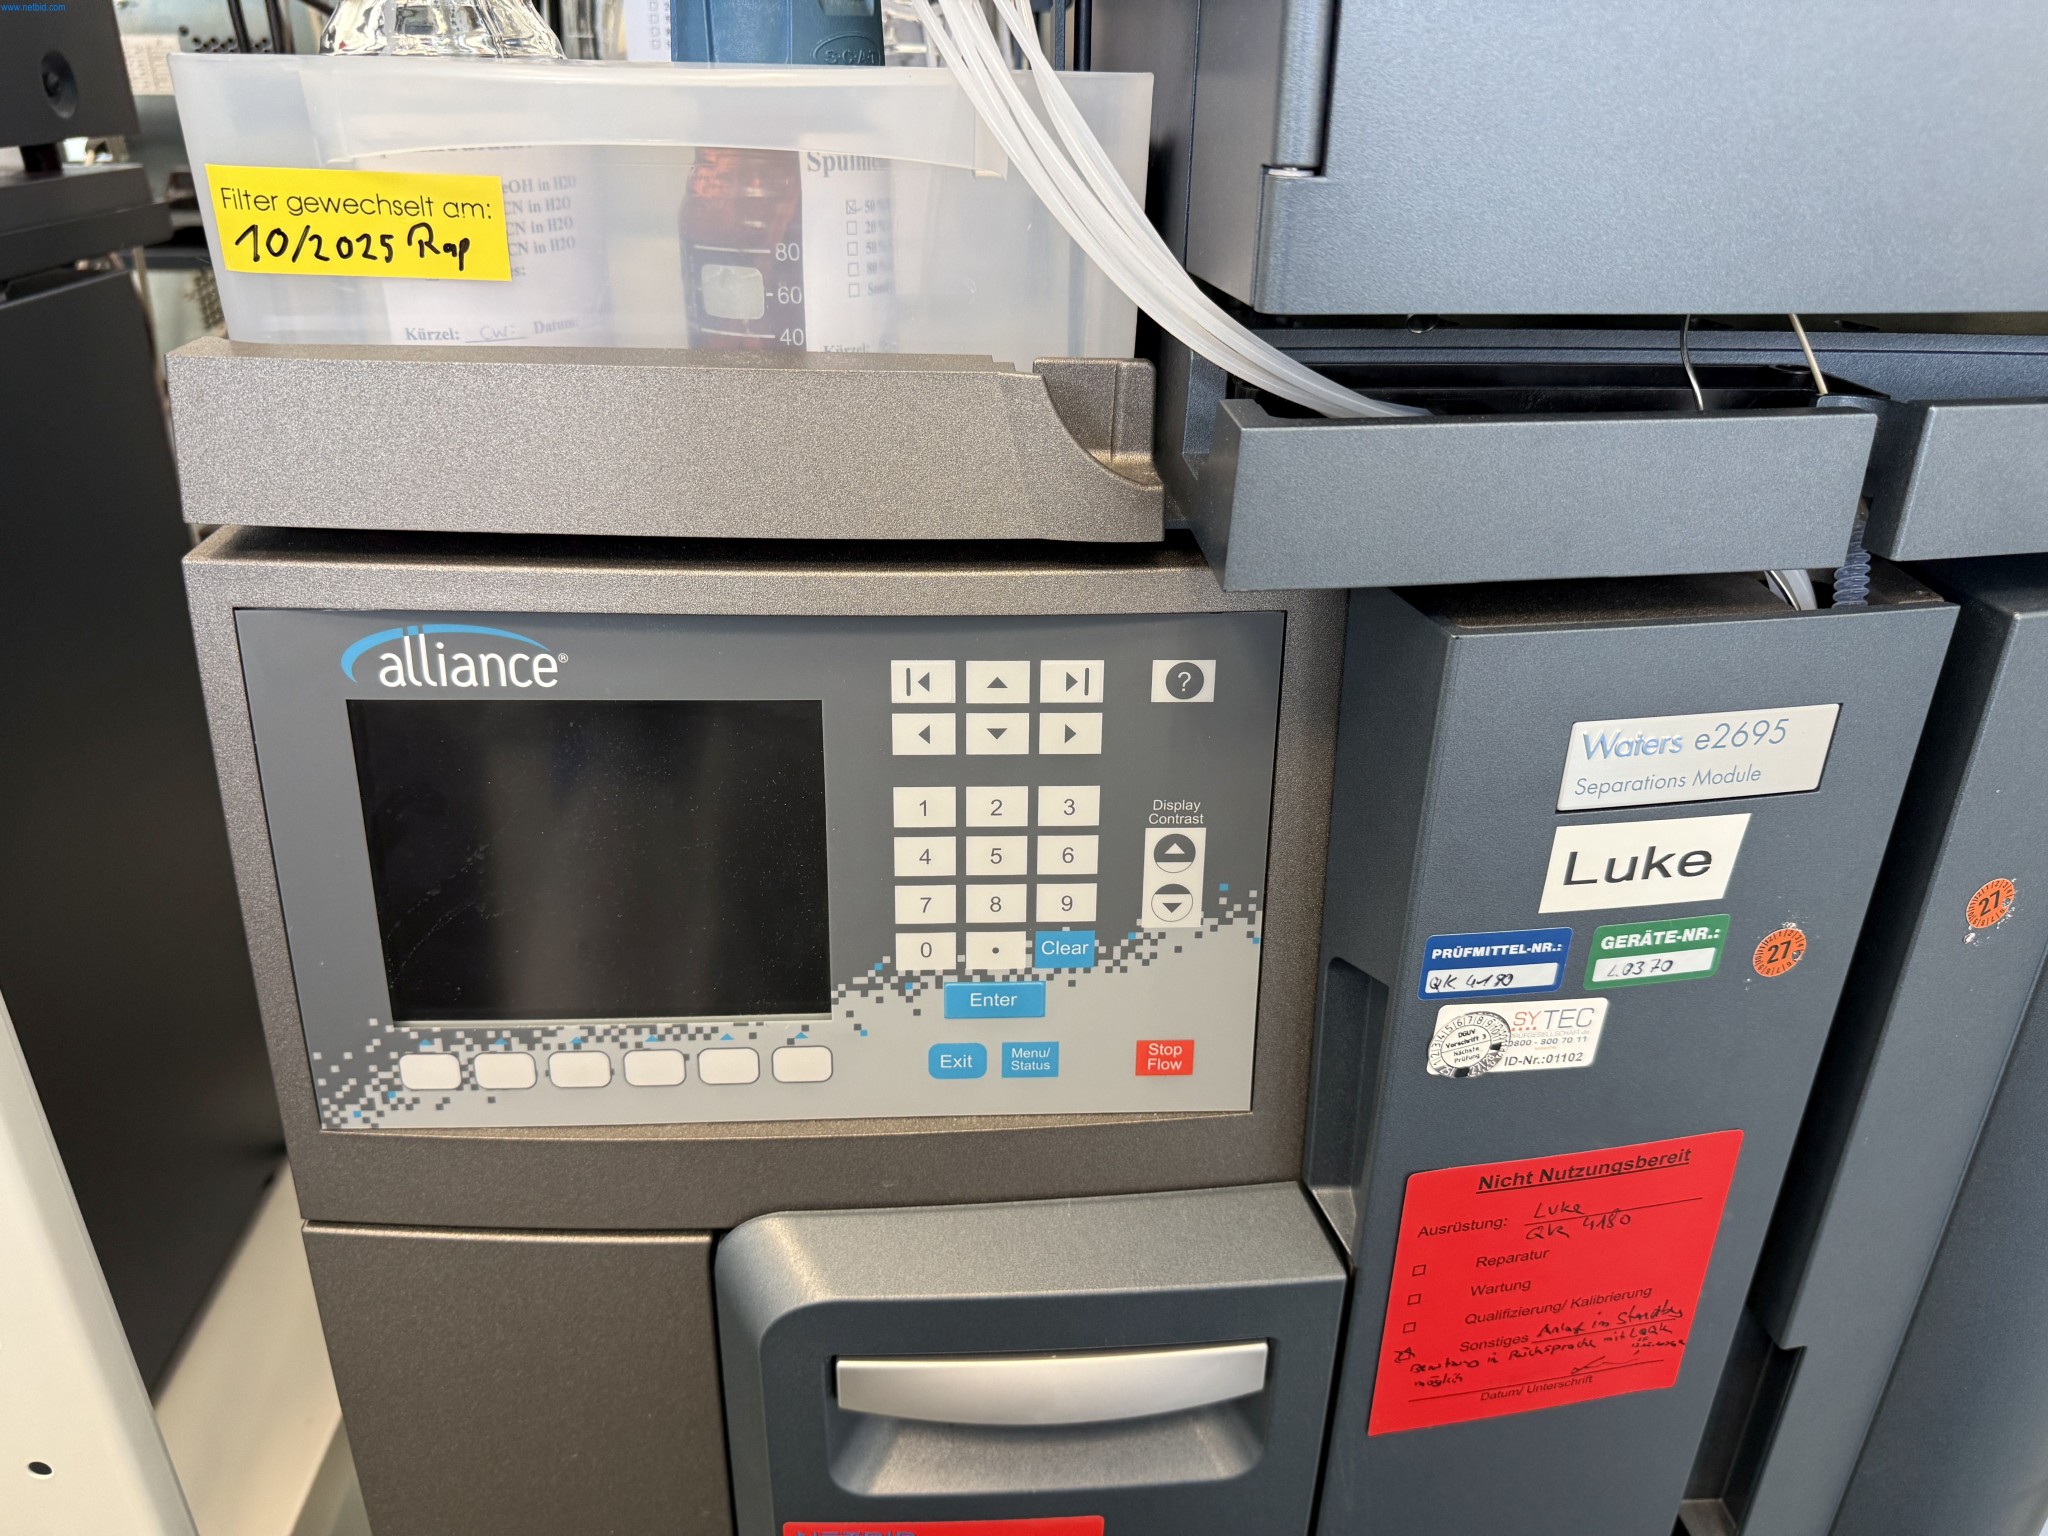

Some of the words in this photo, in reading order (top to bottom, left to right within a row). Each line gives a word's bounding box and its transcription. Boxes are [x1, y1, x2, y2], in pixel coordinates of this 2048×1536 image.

[502, 178, 533, 194] eOH
[221, 187, 279, 212] Filter
[286, 193, 434, 217] gewechselt
[442, 200, 493, 219] am:
[235, 223, 395, 264] 10/2025
[775, 242, 800, 262] 80
[777, 285, 802, 305] 60
[405, 327, 460, 342] Kürzel:
[779, 328, 804, 346] 40
[1583, 727, 1683, 760] Waters
[1694, 718, 1790, 751] e2695
[1574, 774, 1686, 799] Separations
[1692, 763, 1762, 787] Module
[918, 799, 929, 817] 1
[989, 799, 1003, 817] 2
[1063, 798, 1076, 816] 3
[1153, 799, 1201, 815] Display
[1148, 812, 1204, 825] Contrast
[918, 848, 932, 865] 4
[989, 847, 1003, 864] 5
[1061, 847, 1075, 864] 6
[1563, 846, 1713, 886] Luke
[919, 897, 932, 914] 7
[989, 896, 1002, 913] 8
[1060, 895, 1074, 912] 9
[1978, 889, 2001, 918] 27
[1601, 927, 1721, 950] GERÄTE-NR.:
[920, 941, 932, 959] 0
[1041, 939, 1089, 957] Clear
[1431, 942, 1563, 960] PRÜFMITTEL-NR.:
[1767, 939, 1792, 964] 27
[1429, 974, 1457, 992] QK
[969, 992, 1018, 1008] Enter
[1513, 1007, 1596, 1029] SYTEC
[1457, 1028, 1476, 1038] DGUV
[1148, 1043, 1183, 1058] Stop
[1445, 1036, 1479, 1049] Vorschrift
[1453, 1046, 1480, 1056] Nächste
[940, 1054, 973, 1069] Exit
[1011, 1047, 1051, 1059] Menu/
[1454, 1053, 1480, 1063] Prüfung
[1504, 1051, 1583, 1067] ID-Nr.:01102
[1011, 1060, 1051, 1071] Status
[1147, 1058, 1183, 1071] Flow
[1478, 1170, 1533, 1191] Nicht
[1538, 1149, 1692, 1183] Nutzungsbereit
[1417, 1217, 1508, 1238] Ausrüstung:
[1582, 1208, 1631, 1231] 4180
[1475, 1250, 1550, 1268] Reparatur
[1470, 1280, 1531, 1297] Wartung
[1464, 1300, 1567, 1325] Qualifizierung/
[1570, 1287, 1652, 1309] Kalibrierung
[1459, 1334, 1529, 1353] Sonstiges
[1479, 1385, 1525, 1402] Datum/
[1526, 1374, 1594, 1395] Unterschrift
